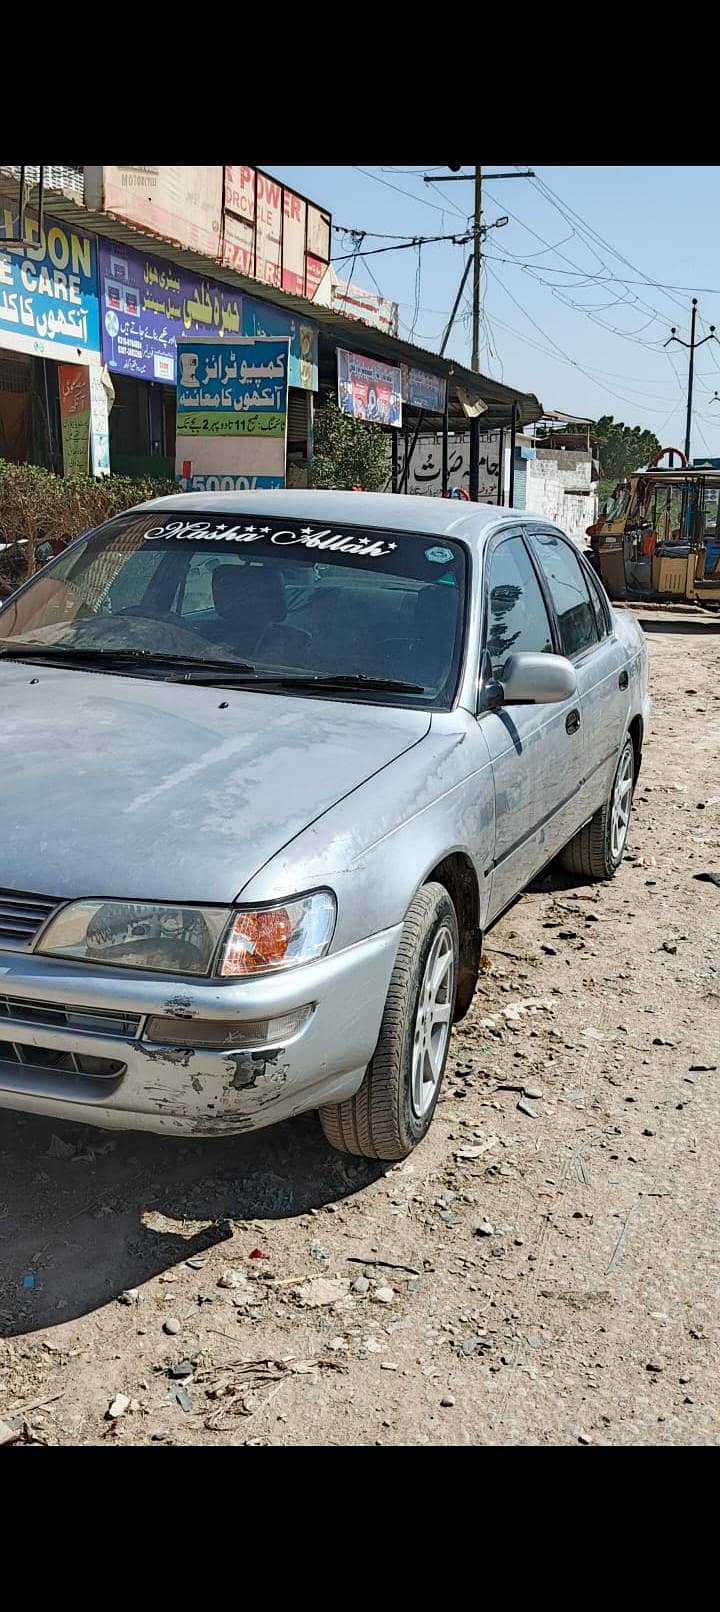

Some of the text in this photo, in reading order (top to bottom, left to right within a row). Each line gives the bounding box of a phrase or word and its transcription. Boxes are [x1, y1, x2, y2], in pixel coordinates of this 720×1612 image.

[21, 260, 82, 305] CARE
[233, 386, 283, 411] آنکھوں
[203, 419, 209, 430] 2
[236, 419, 246, 431] 11
[143, 521, 265, 542] Masha
